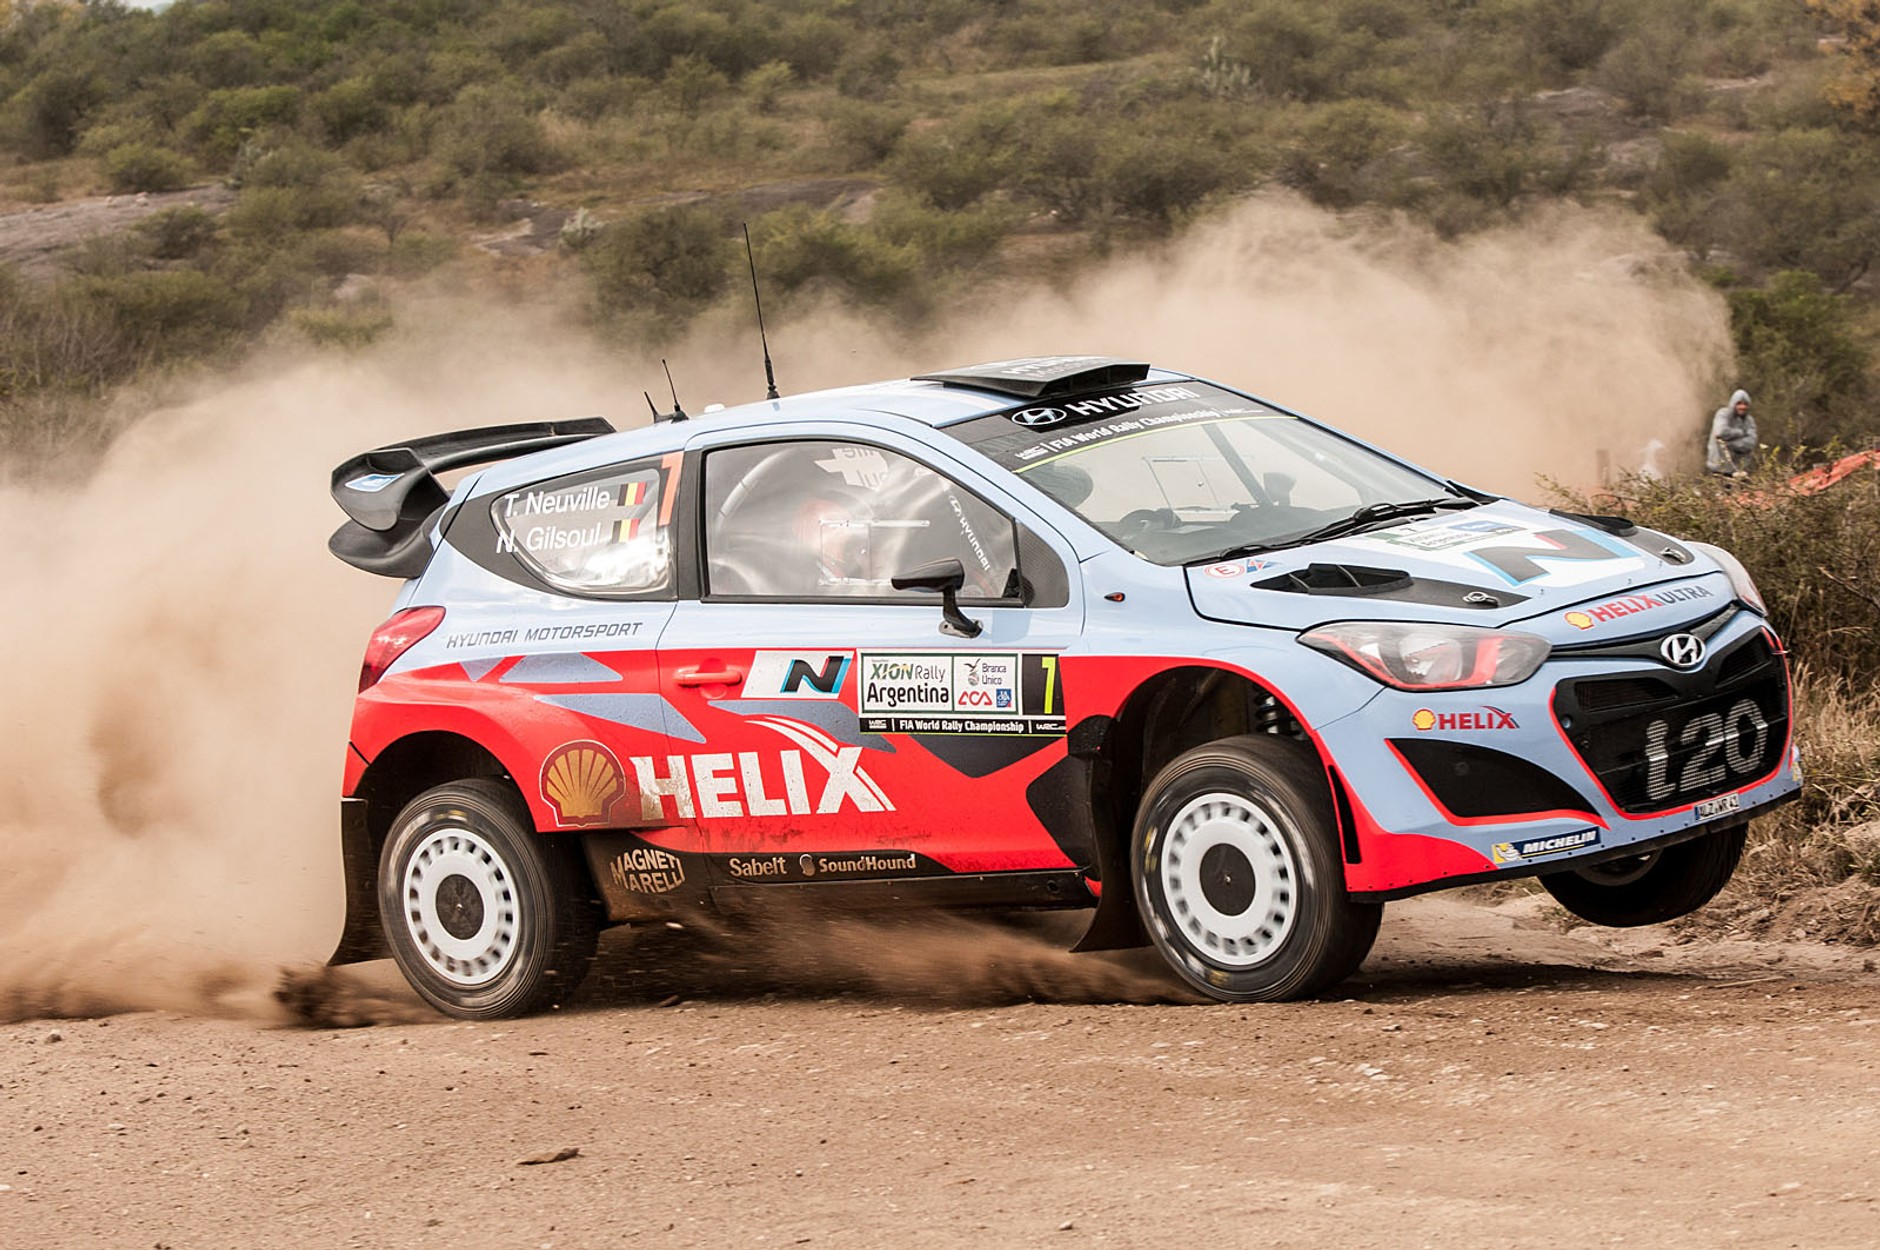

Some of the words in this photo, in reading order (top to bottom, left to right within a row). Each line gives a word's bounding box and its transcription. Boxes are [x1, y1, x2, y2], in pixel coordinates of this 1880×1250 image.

[1064, 386, 1201, 416] HYUNDAI
[1050, 437, 1079, 450] FIA
[1070, 426, 1114, 443] World
[504, 493, 520, 518] T.
[525, 486, 611, 516] Neuville
[496, 528, 519, 554] N.
[526, 522, 602, 551] Gilsoul
[959, 516, 991, 572] HYUNDAI
[1214, 565, 1236, 575] E
[1587, 594, 1664, 622] HELIX
[1655, 585, 1714, 604] ULTRA
[446, 629, 519, 649] HYUNDAI
[524, 622, 644, 643] MOTORSPORT
[780, 655, 852, 693] N
[870, 662, 914, 680] XION
[914, 664, 946, 683] Rally
[981, 662, 1007, 673] Branca
[866, 681, 950, 708] Argentina
[958, 690, 993, 706] ACA
[899, 720, 914, 731] FIA
[915, 720, 940, 731] World
[941, 720, 963, 733] Rally
[964, 720, 1024, 734] Championship
[1437, 705, 1520, 730] HELIX
[629, 717, 897, 821] HELIX
[1523, 830, 1597, 854] MICHELIN
[729, 856, 787, 877] Sabelt
[819, 854, 917, 873] SoundHound
